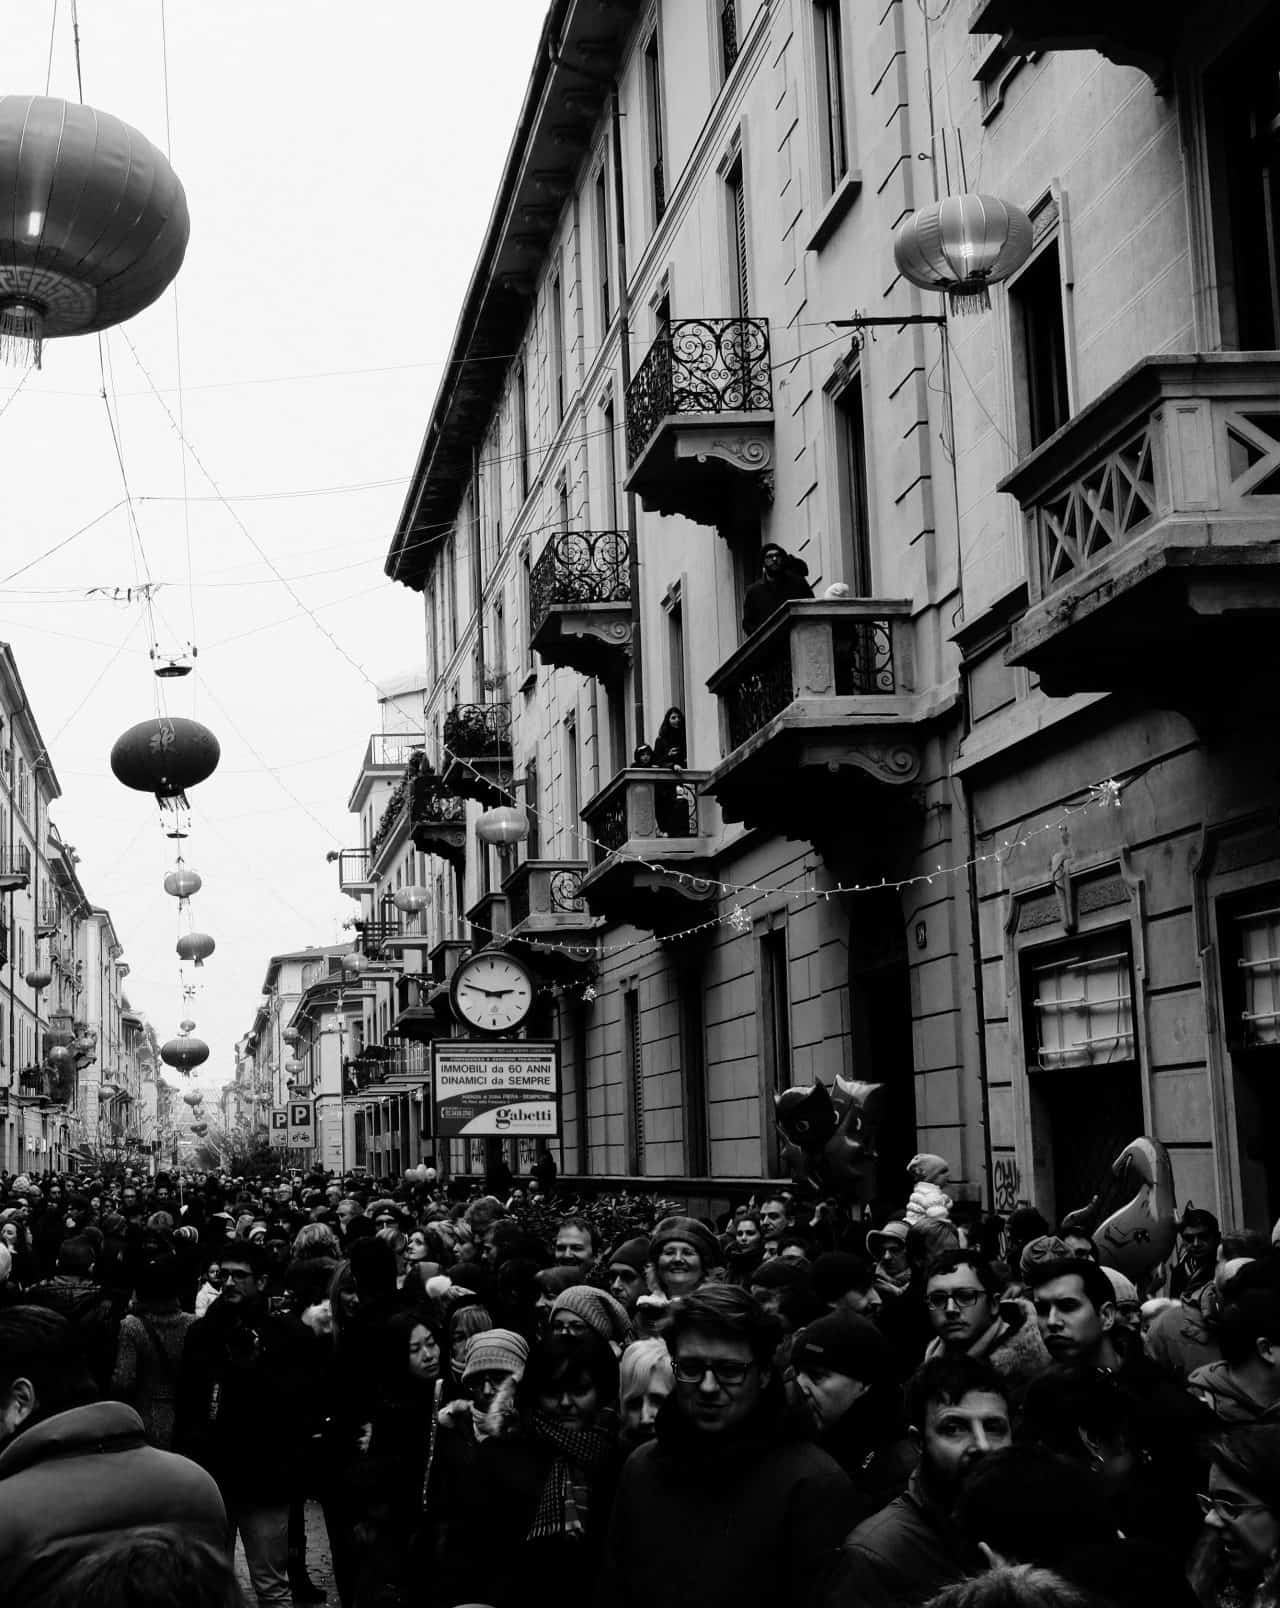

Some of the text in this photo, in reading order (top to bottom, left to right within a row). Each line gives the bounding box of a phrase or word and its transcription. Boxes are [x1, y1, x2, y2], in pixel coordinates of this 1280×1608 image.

[441, 1064, 551, 1073] IMMOBILI da 60 ANNI
[441, 1076, 551, 1085] DINAMICI da SEMPRE
[276, 1114, 286, 1127] P
[296, 1107, 307, 1124] P
[496, 1108, 552, 1129] gabetti
